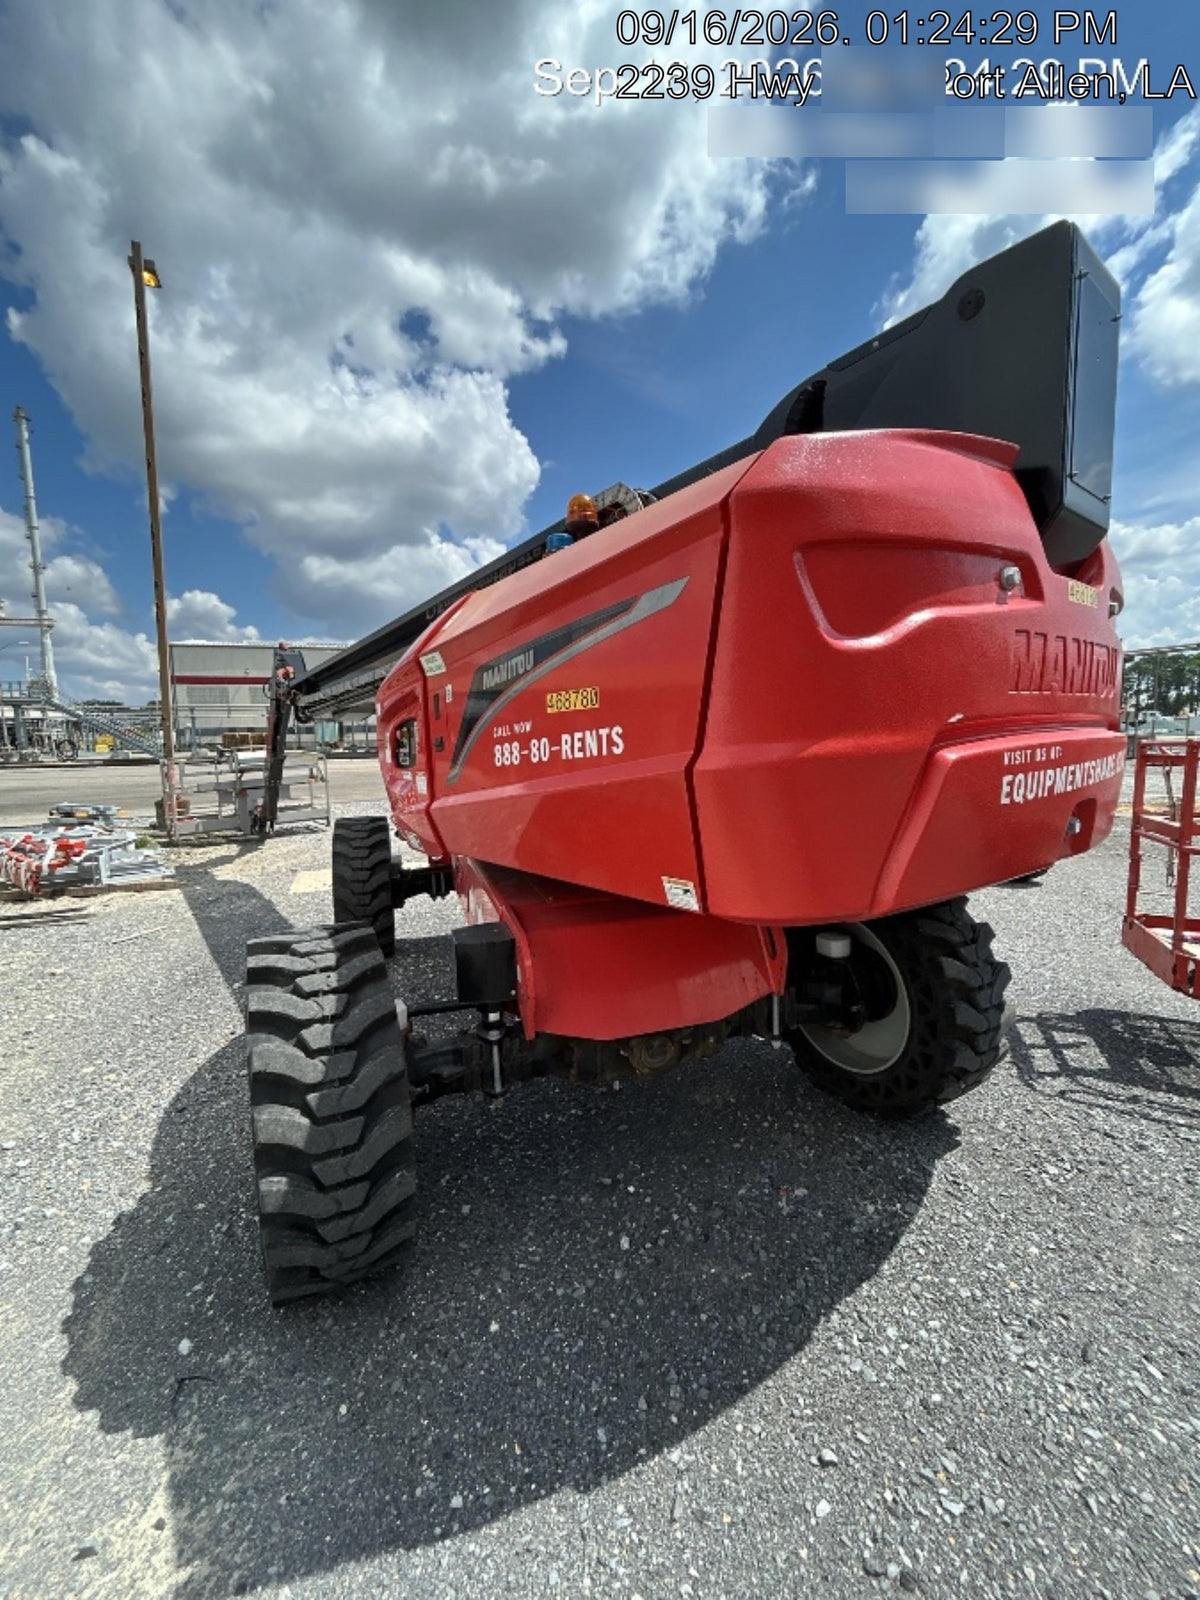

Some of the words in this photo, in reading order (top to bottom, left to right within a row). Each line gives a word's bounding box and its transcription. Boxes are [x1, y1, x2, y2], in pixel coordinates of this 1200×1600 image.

[482, 647, 535, 691] MANITOU
[1008, 629, 1118, 698] MANITOU
[547, 687, 598, 711] 468780
[493, 724, 512, 739] CALL
[513, 719, 533, 734] NOW
[493, 724, 625, 767] 888-80-RENTS
[1004, 749, 1032, 766] VISIT
